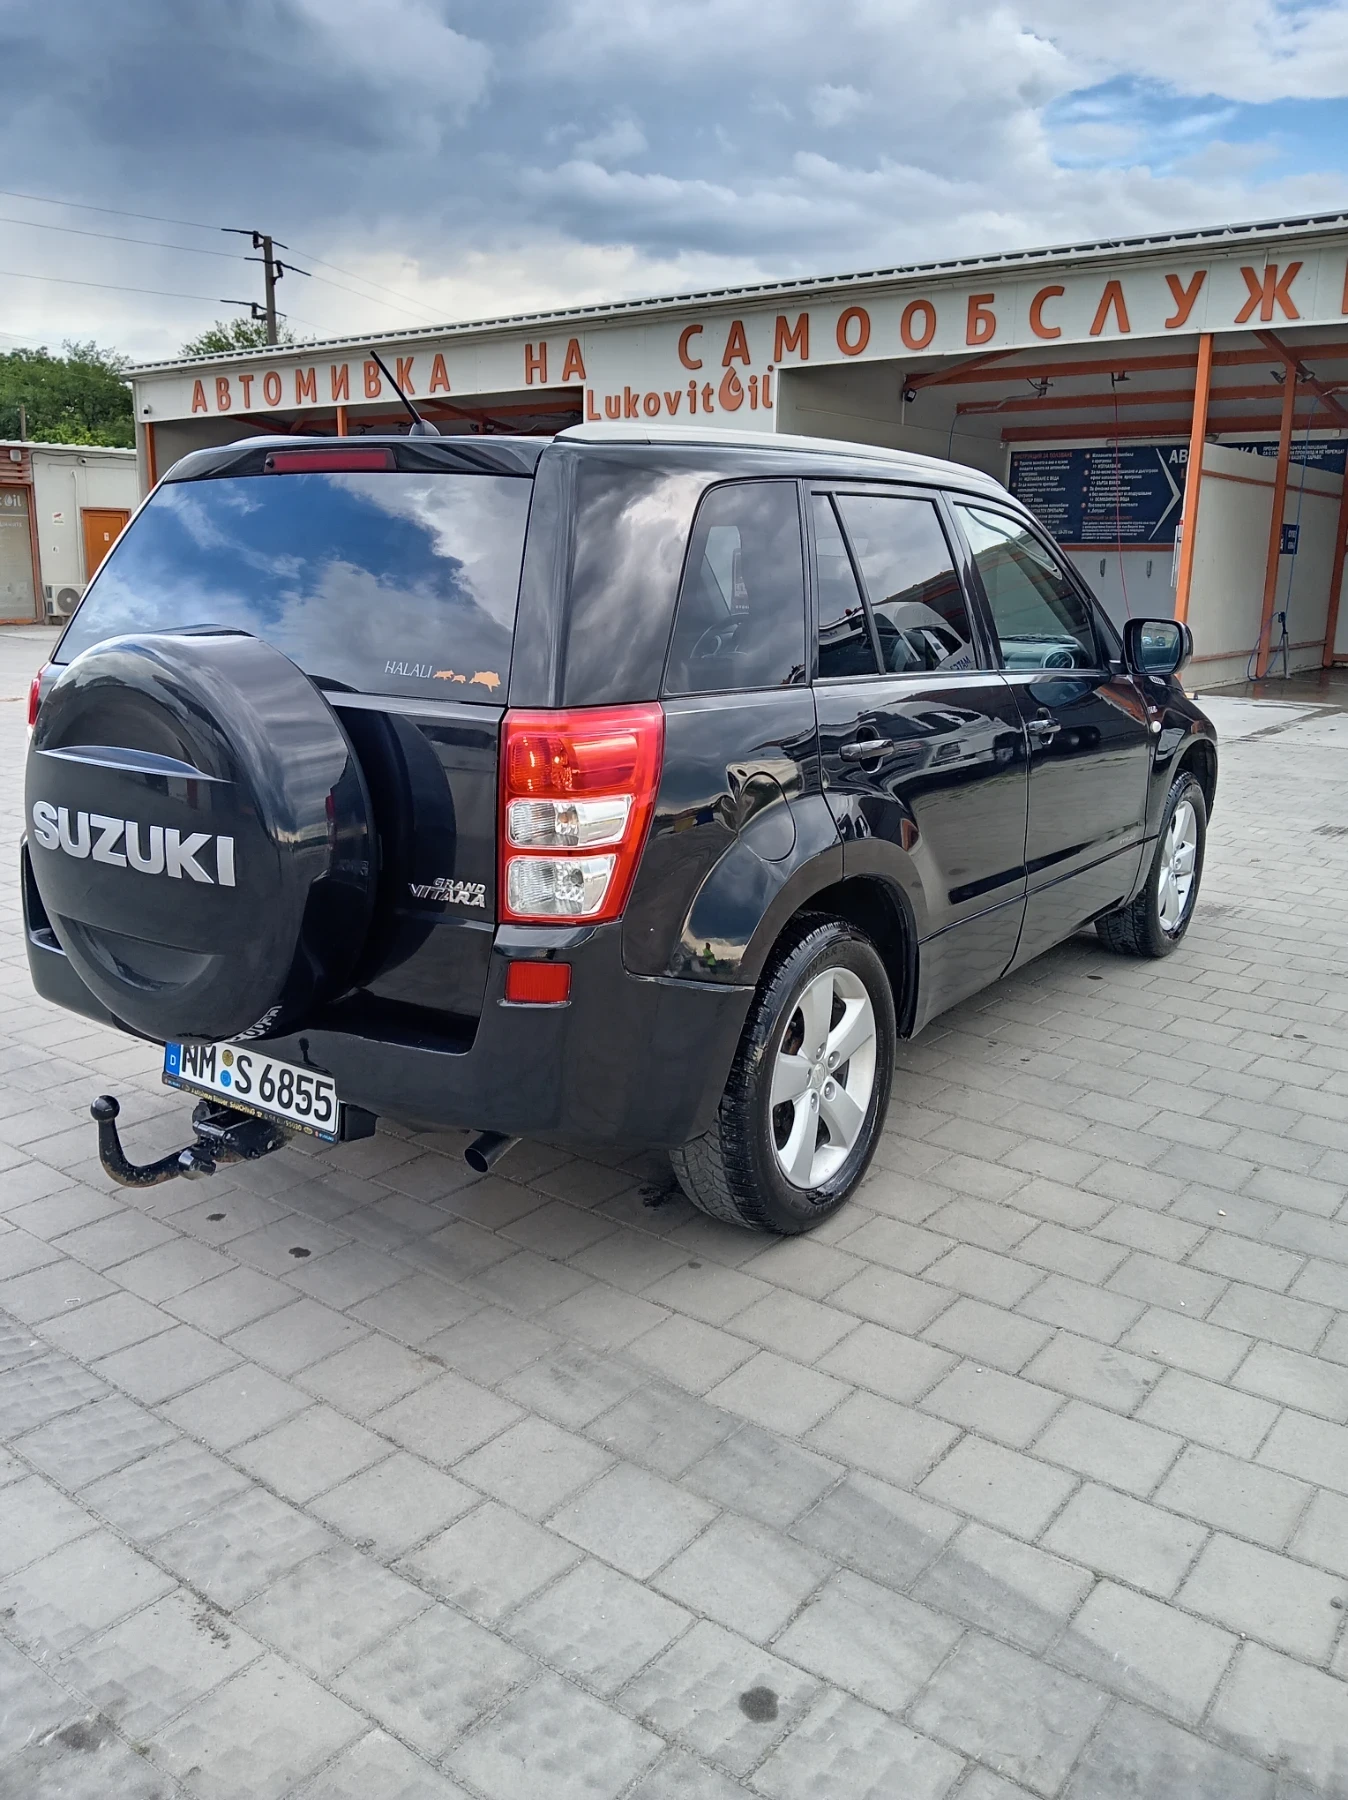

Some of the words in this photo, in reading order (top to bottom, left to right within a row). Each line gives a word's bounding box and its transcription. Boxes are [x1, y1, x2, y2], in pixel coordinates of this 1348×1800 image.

[191, 353, 451, 413] АВТОМИВКА
[524, 338, 586, 385] НА
[678, 258, 1348, 370] САМООБСЛУЖ
[384, 660, 433, 679] HALALI
[32, 800, 236, 887] SUZUKI
[408, 882, 486, 908] VITARA
[433, 877, 486, 894] GRAND
[181, 1044, 217, 1083] NM
[234, 1055, 253, 1095] S
[259, 1063, 334, 1122] 6855
